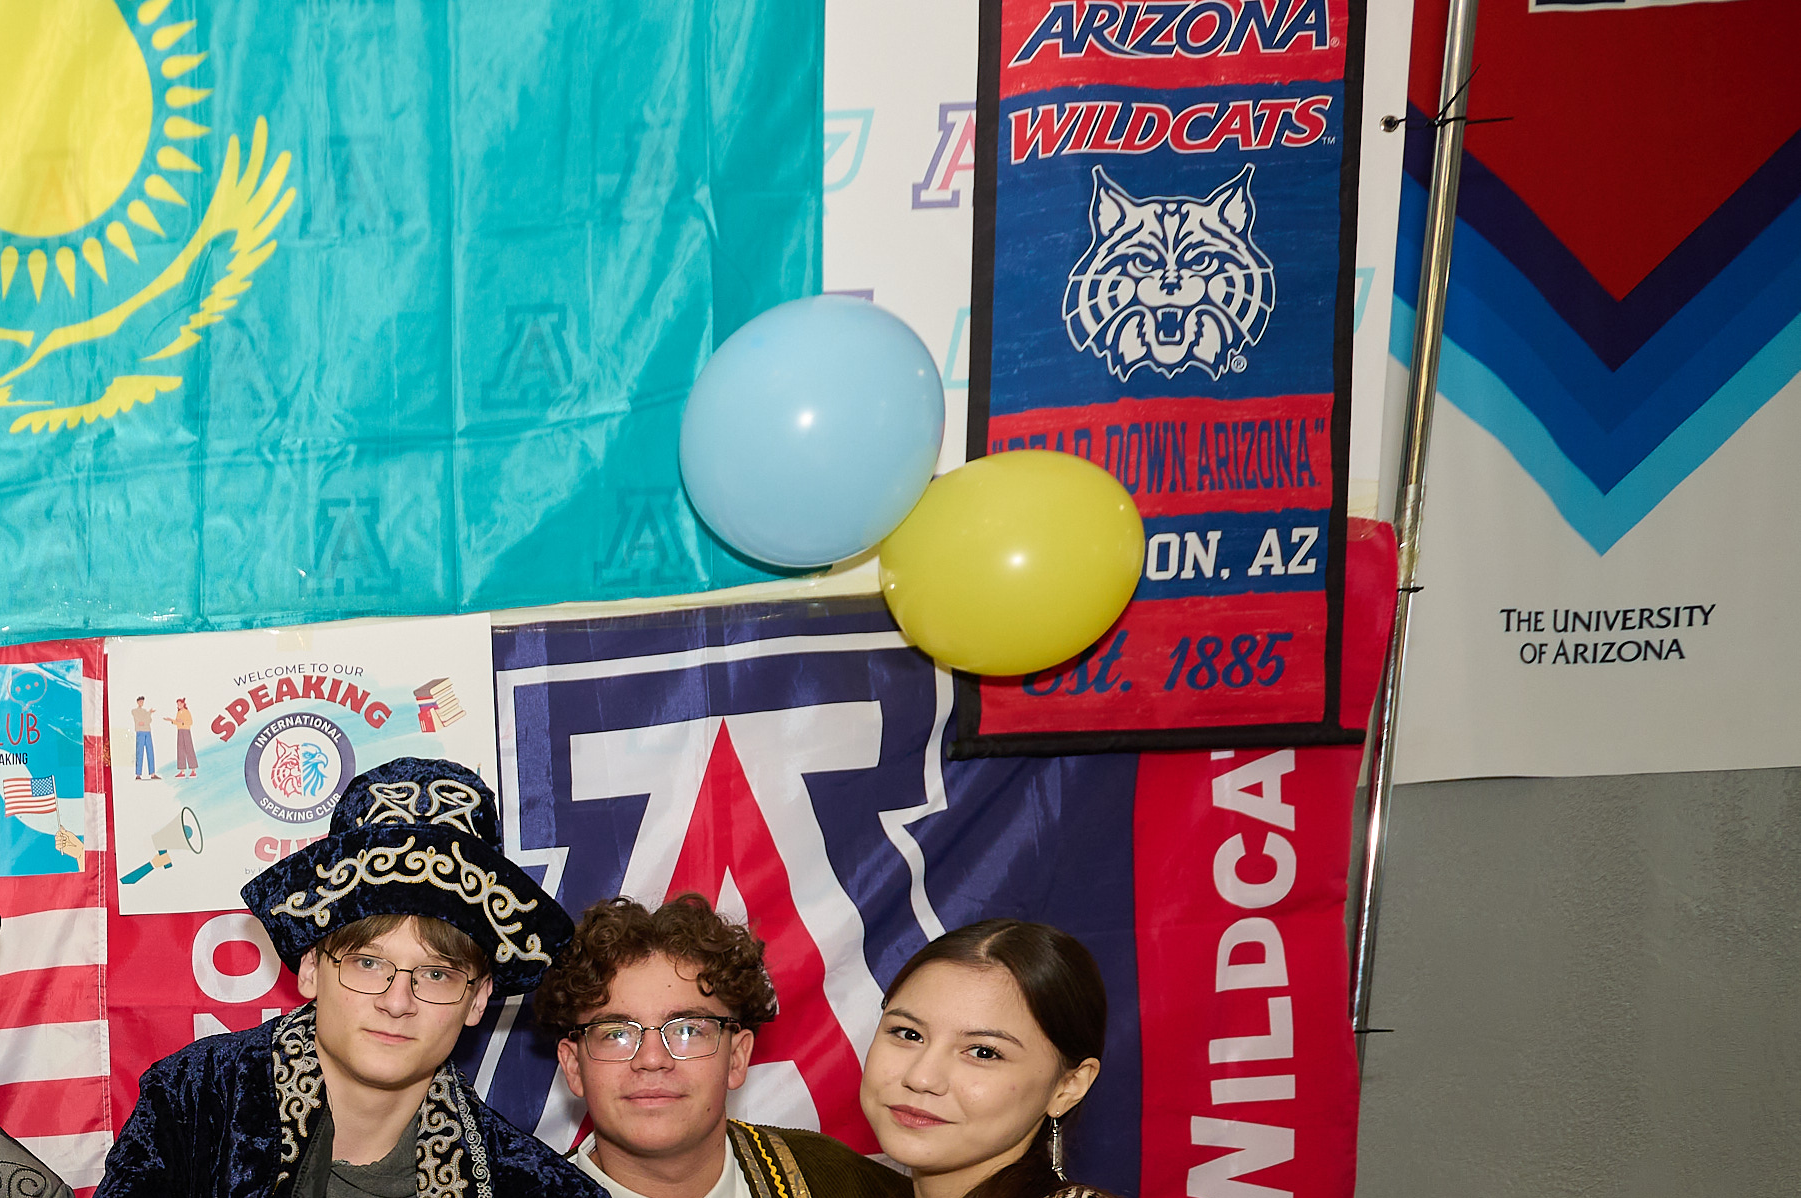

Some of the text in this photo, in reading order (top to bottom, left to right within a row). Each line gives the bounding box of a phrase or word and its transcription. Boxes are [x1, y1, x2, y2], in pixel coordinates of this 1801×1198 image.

[1007, 0, 1331, 68] ARIZONA
[1008, 95, 1333, 165] WILDCATS
[1247, 526, 1320, 577] AZ
[1500, 604, 1716, 633] THE UNIVERSITY
[1163, 632, 1293, 692] 1885
[1519, 638, 1686, 665] OF ARIZONA
[233, 663, 364, 687] WELCOME TO OUR
[210, 674, 393, 743] SPEAKING
[254, 715, 344, 749] INTERNATIONAL
[259, 792, 341, 821] SPEAKING CLUB
[245, 867, 256, 876] by
